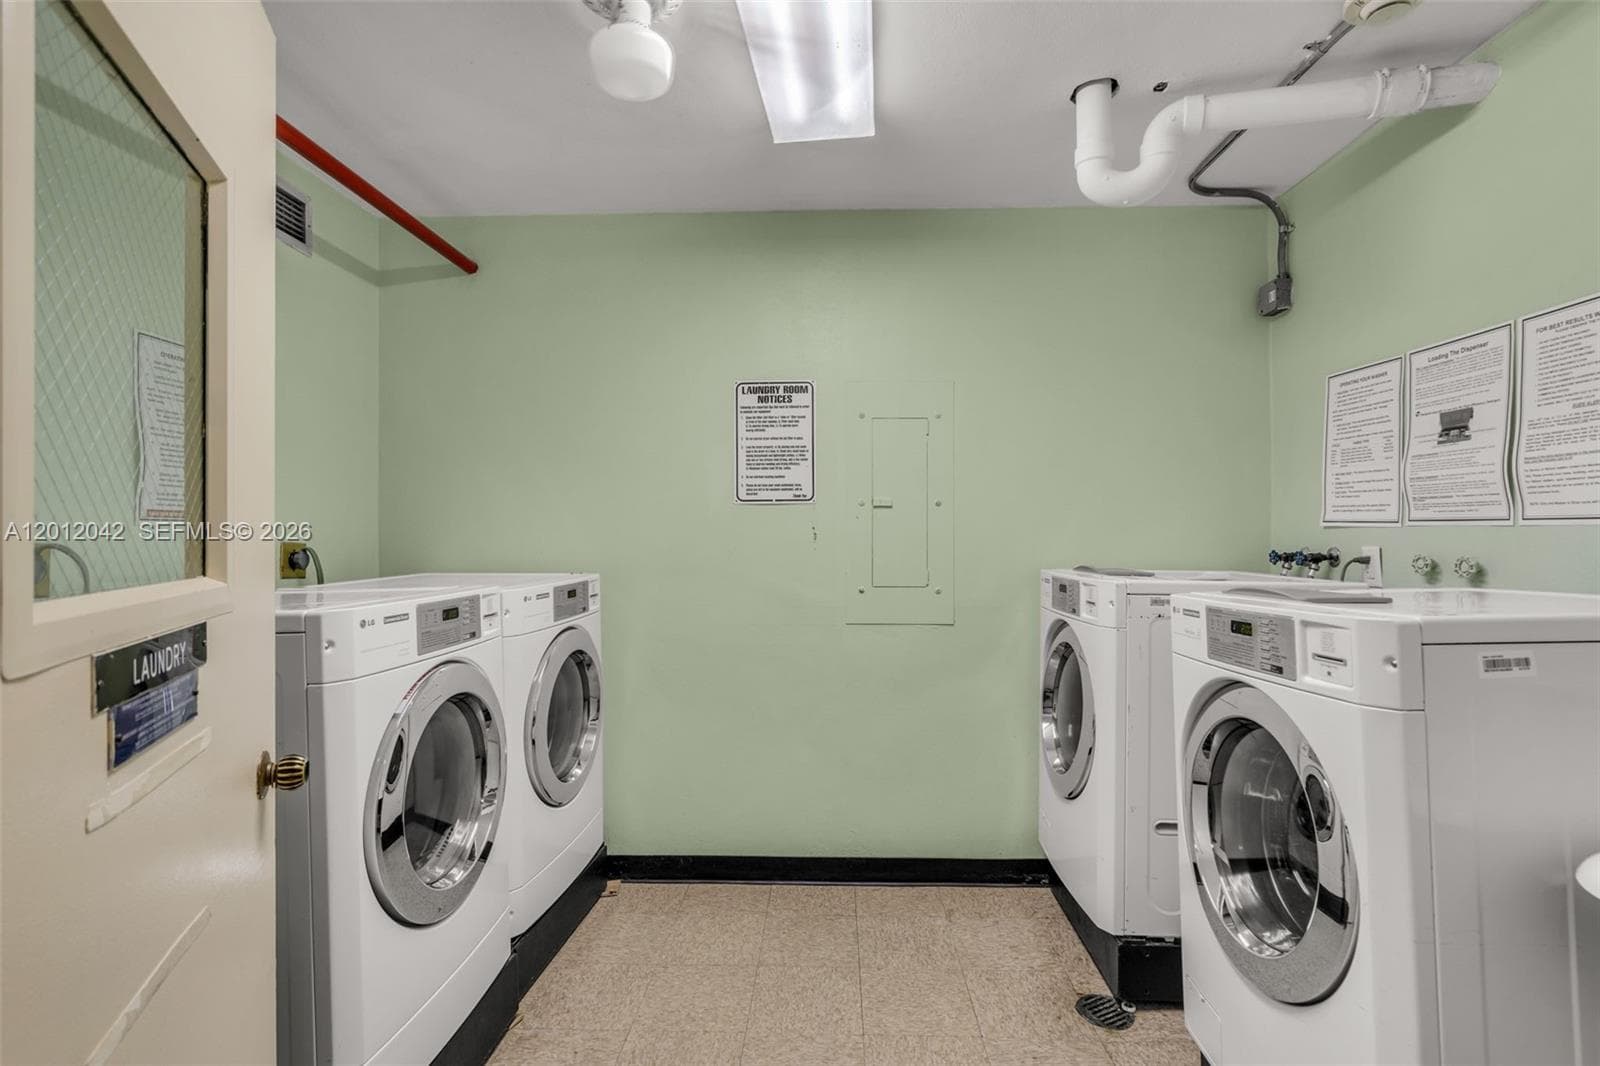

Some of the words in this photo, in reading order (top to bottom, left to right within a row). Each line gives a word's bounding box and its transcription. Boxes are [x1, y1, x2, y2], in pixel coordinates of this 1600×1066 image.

[1536, 325, 1547, 334] FOR
[1549, 320, 1563, 331] BEST
[1565, 313, 1593, 326] RESULTS
[1427, 352, 1449, 363] Loading
[1449, 348, 1459, 356] The
[1460, 341, 1489, 354] Dispenser
[741, 385, 781, 395] LAUNDRY
[783, 385, 809, 394] ROOM
[757, 394, 793, 404] NOTICES
[132, 641, 187, 686] LAUNDRY
